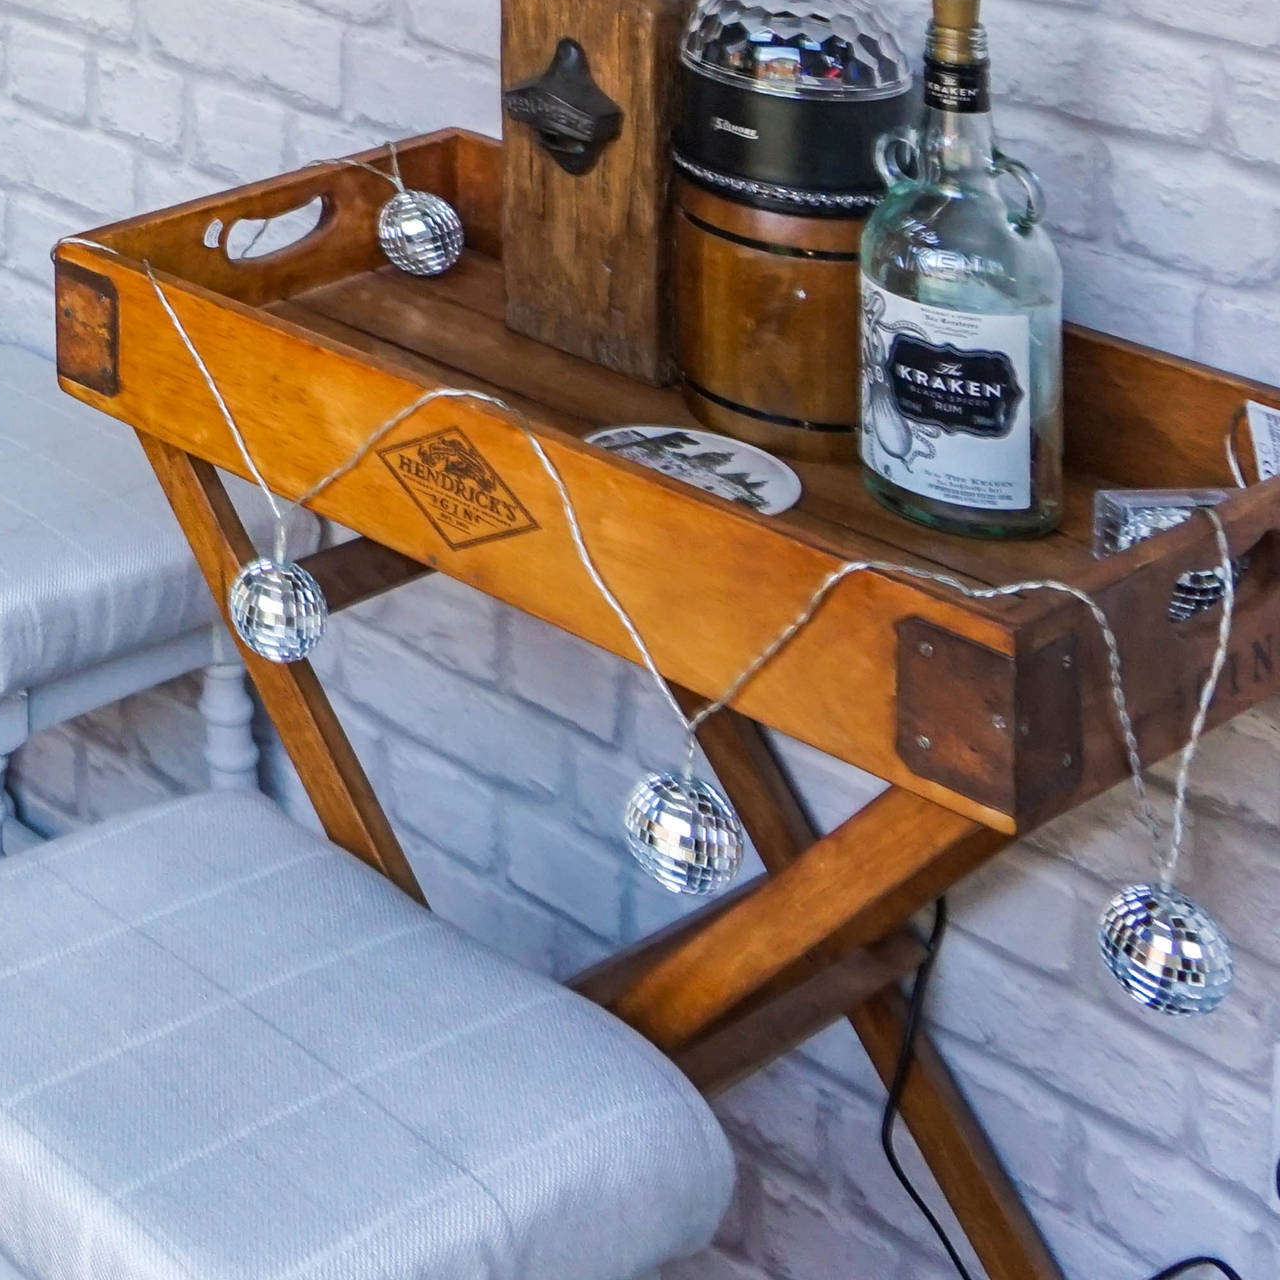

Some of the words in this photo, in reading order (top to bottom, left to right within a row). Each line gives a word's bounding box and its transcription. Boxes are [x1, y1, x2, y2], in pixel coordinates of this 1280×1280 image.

[927, 81, 976, 97] KRAKEN
[898, 364, 1003, 398] KRAKEN
[934, 401, 963, 415] RUM
[399, 453, 517, 521] HENDRICK'S
[440, 498, 473, 521] GIN
